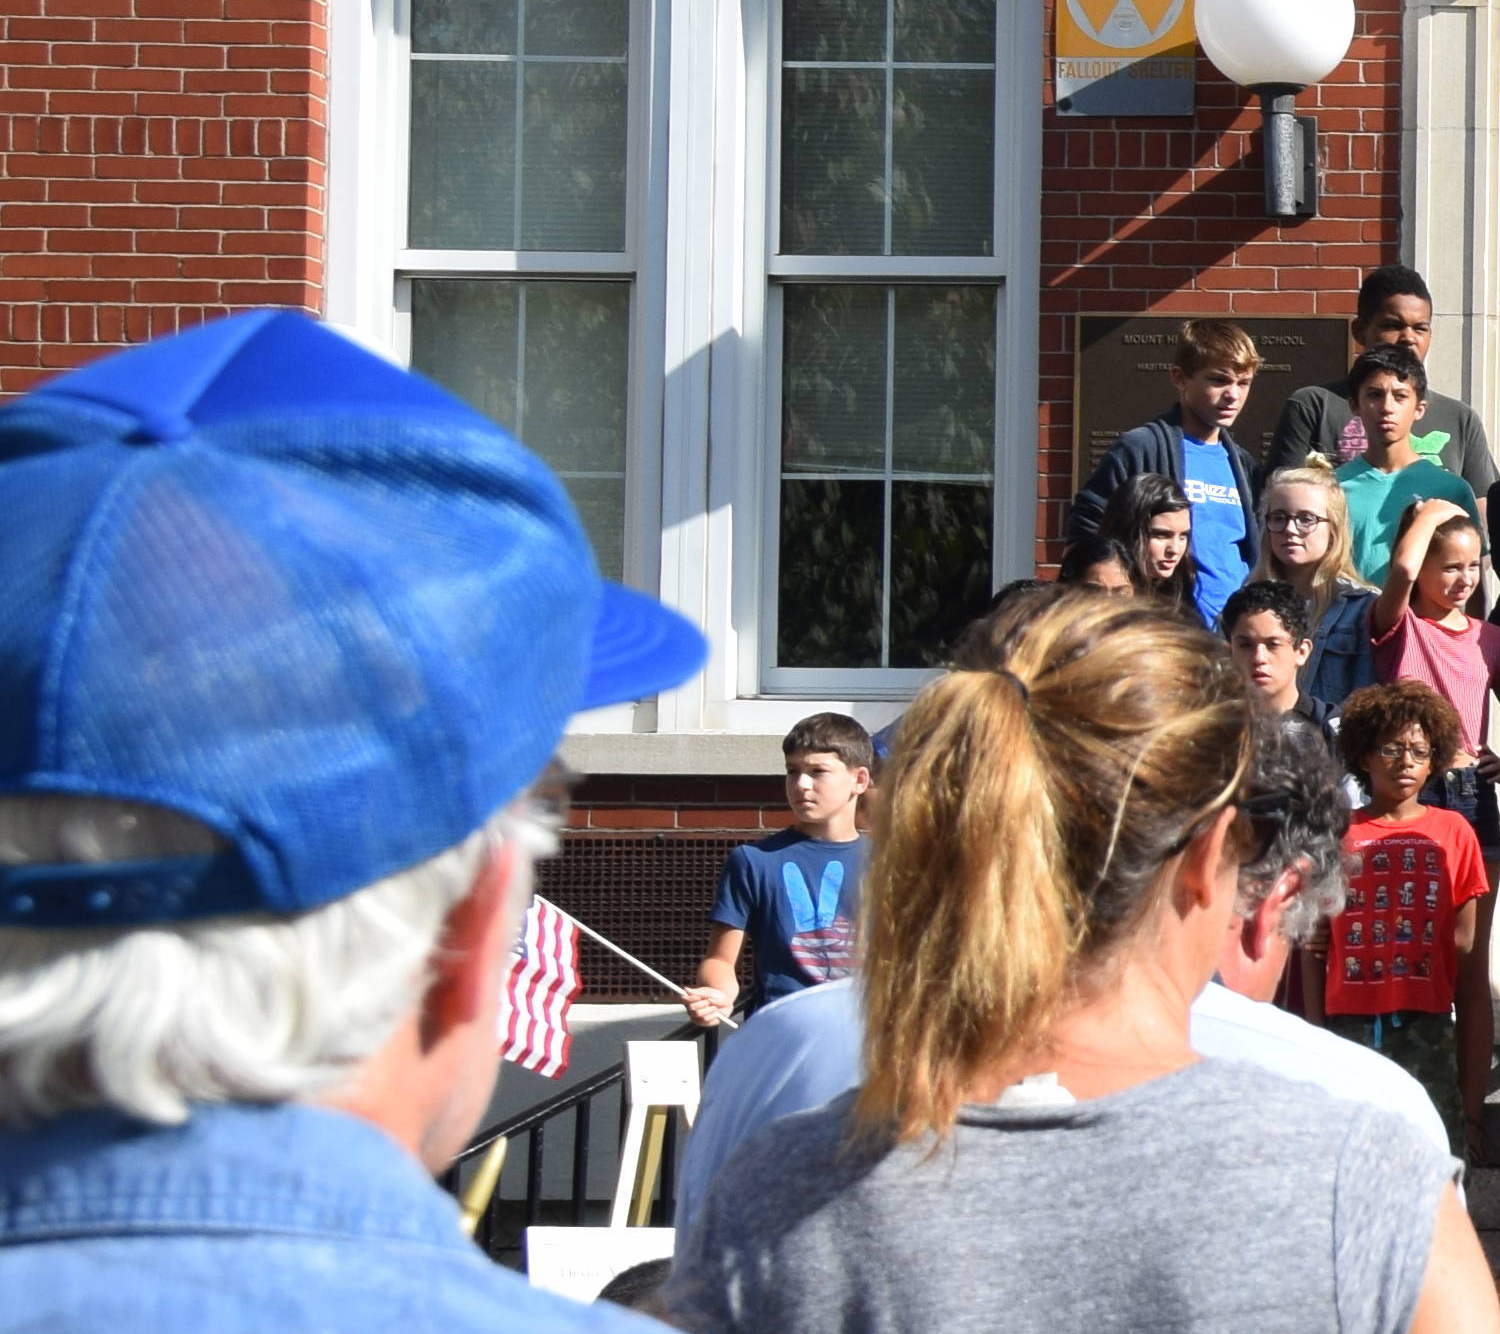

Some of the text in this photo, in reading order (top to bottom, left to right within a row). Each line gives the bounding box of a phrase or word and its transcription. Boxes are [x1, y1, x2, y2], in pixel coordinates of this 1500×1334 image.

[1058, 61, 1193, 79] FALLOUT SHELTER
[1123, 334, 1163, 345] MOUNT
[1260, 335, 1306, 346] SCHOOL
